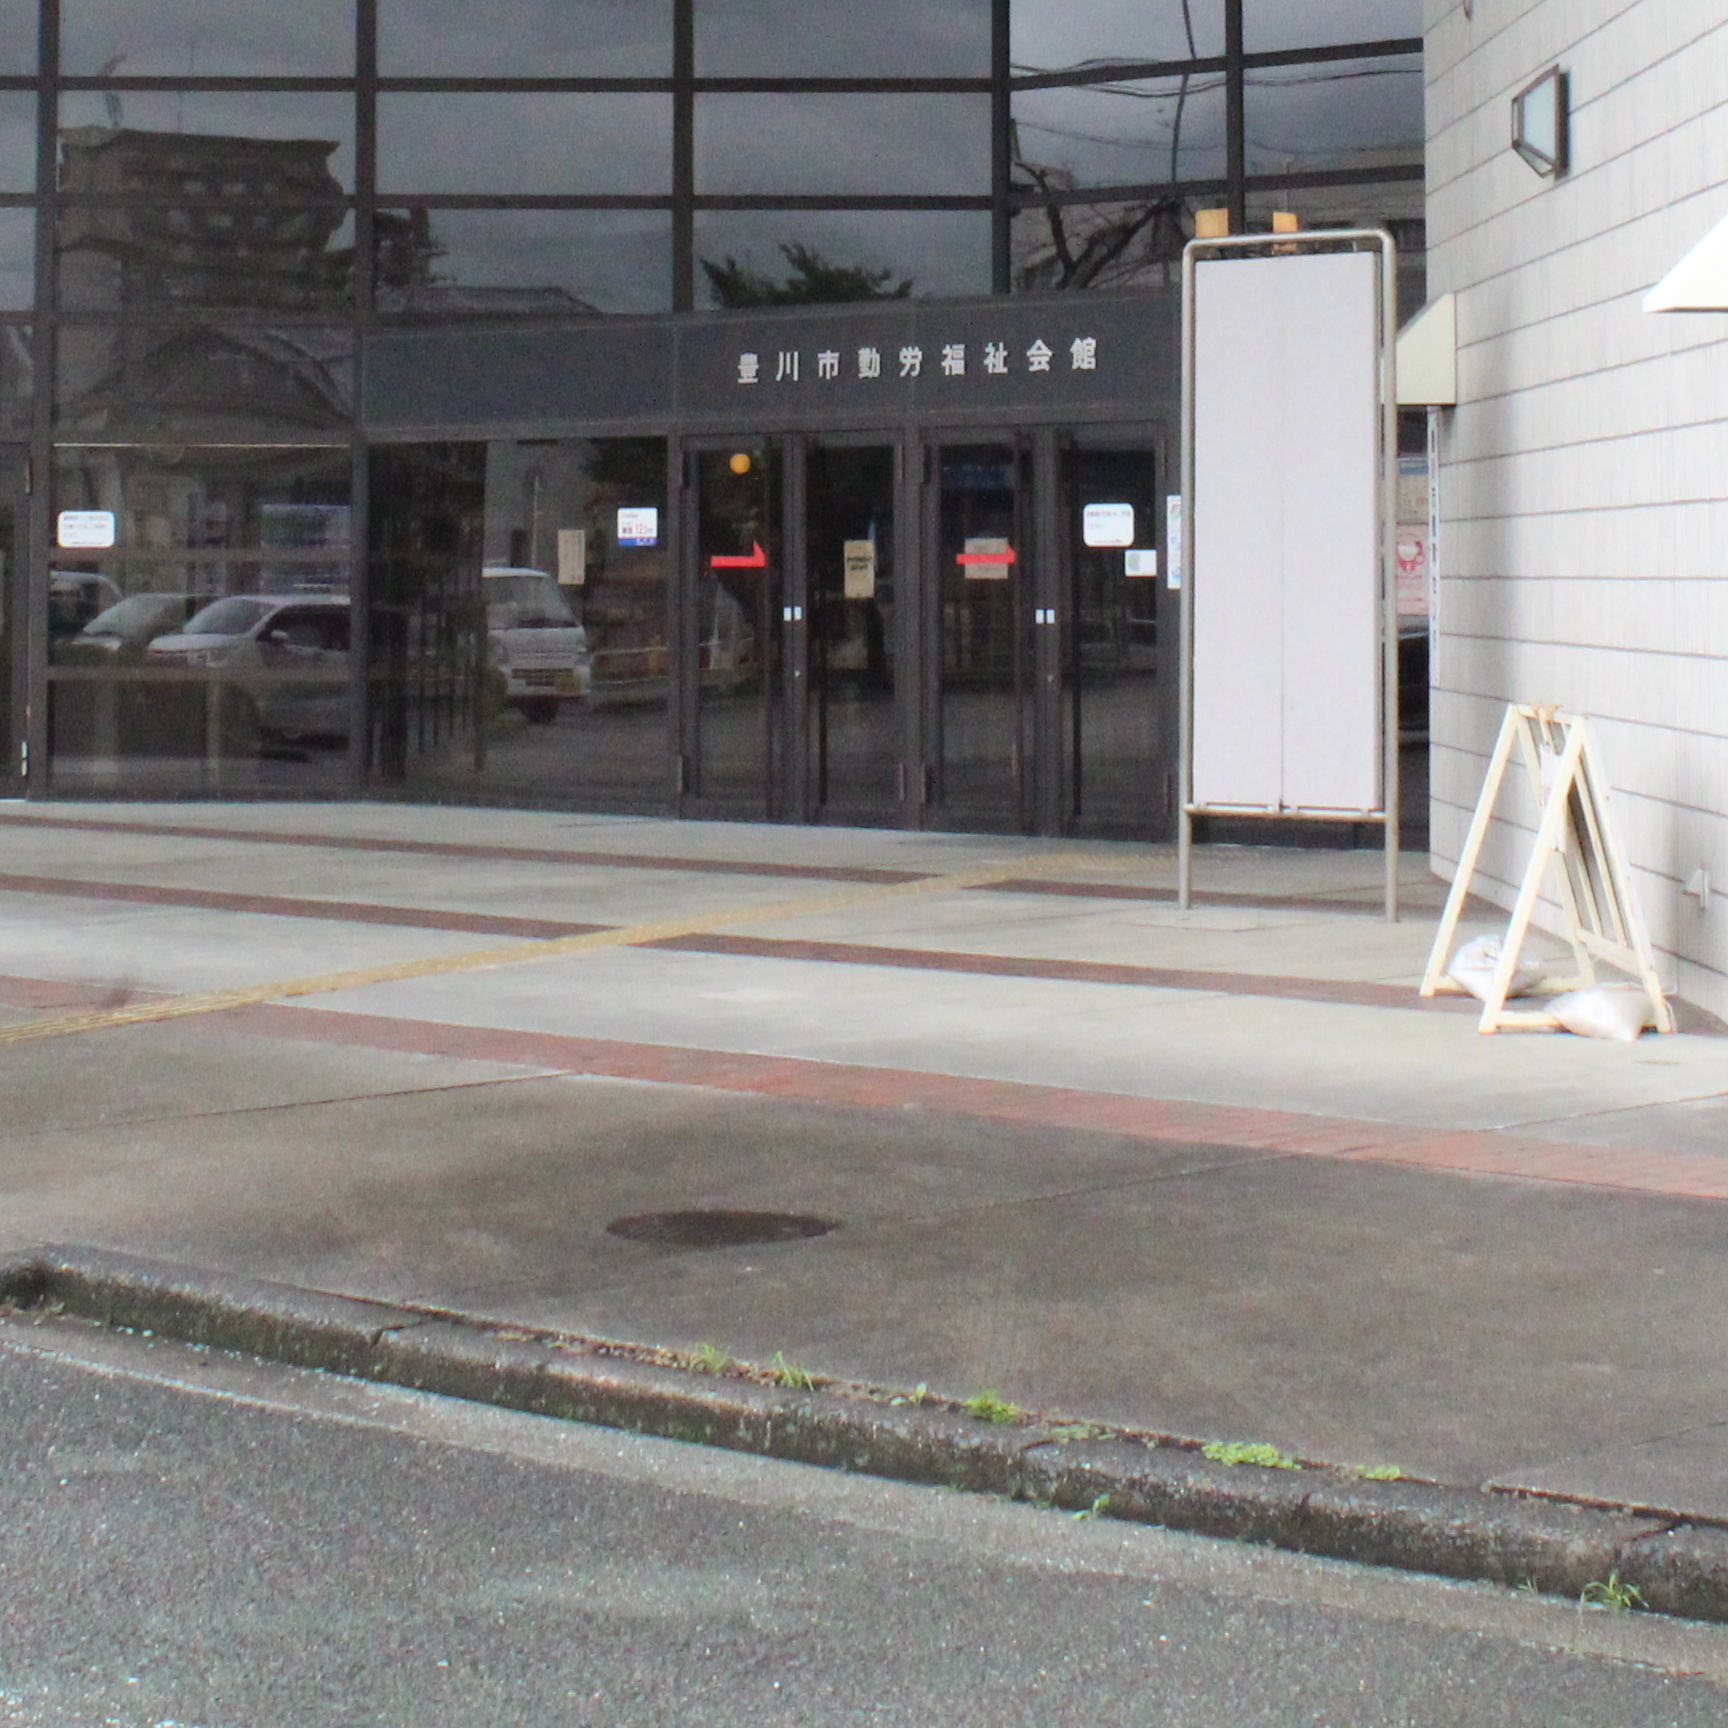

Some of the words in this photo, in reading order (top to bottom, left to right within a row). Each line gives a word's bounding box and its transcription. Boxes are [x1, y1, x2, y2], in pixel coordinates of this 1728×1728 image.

[737, 336, 1097, 384] 豊川市勤労福祉会館
